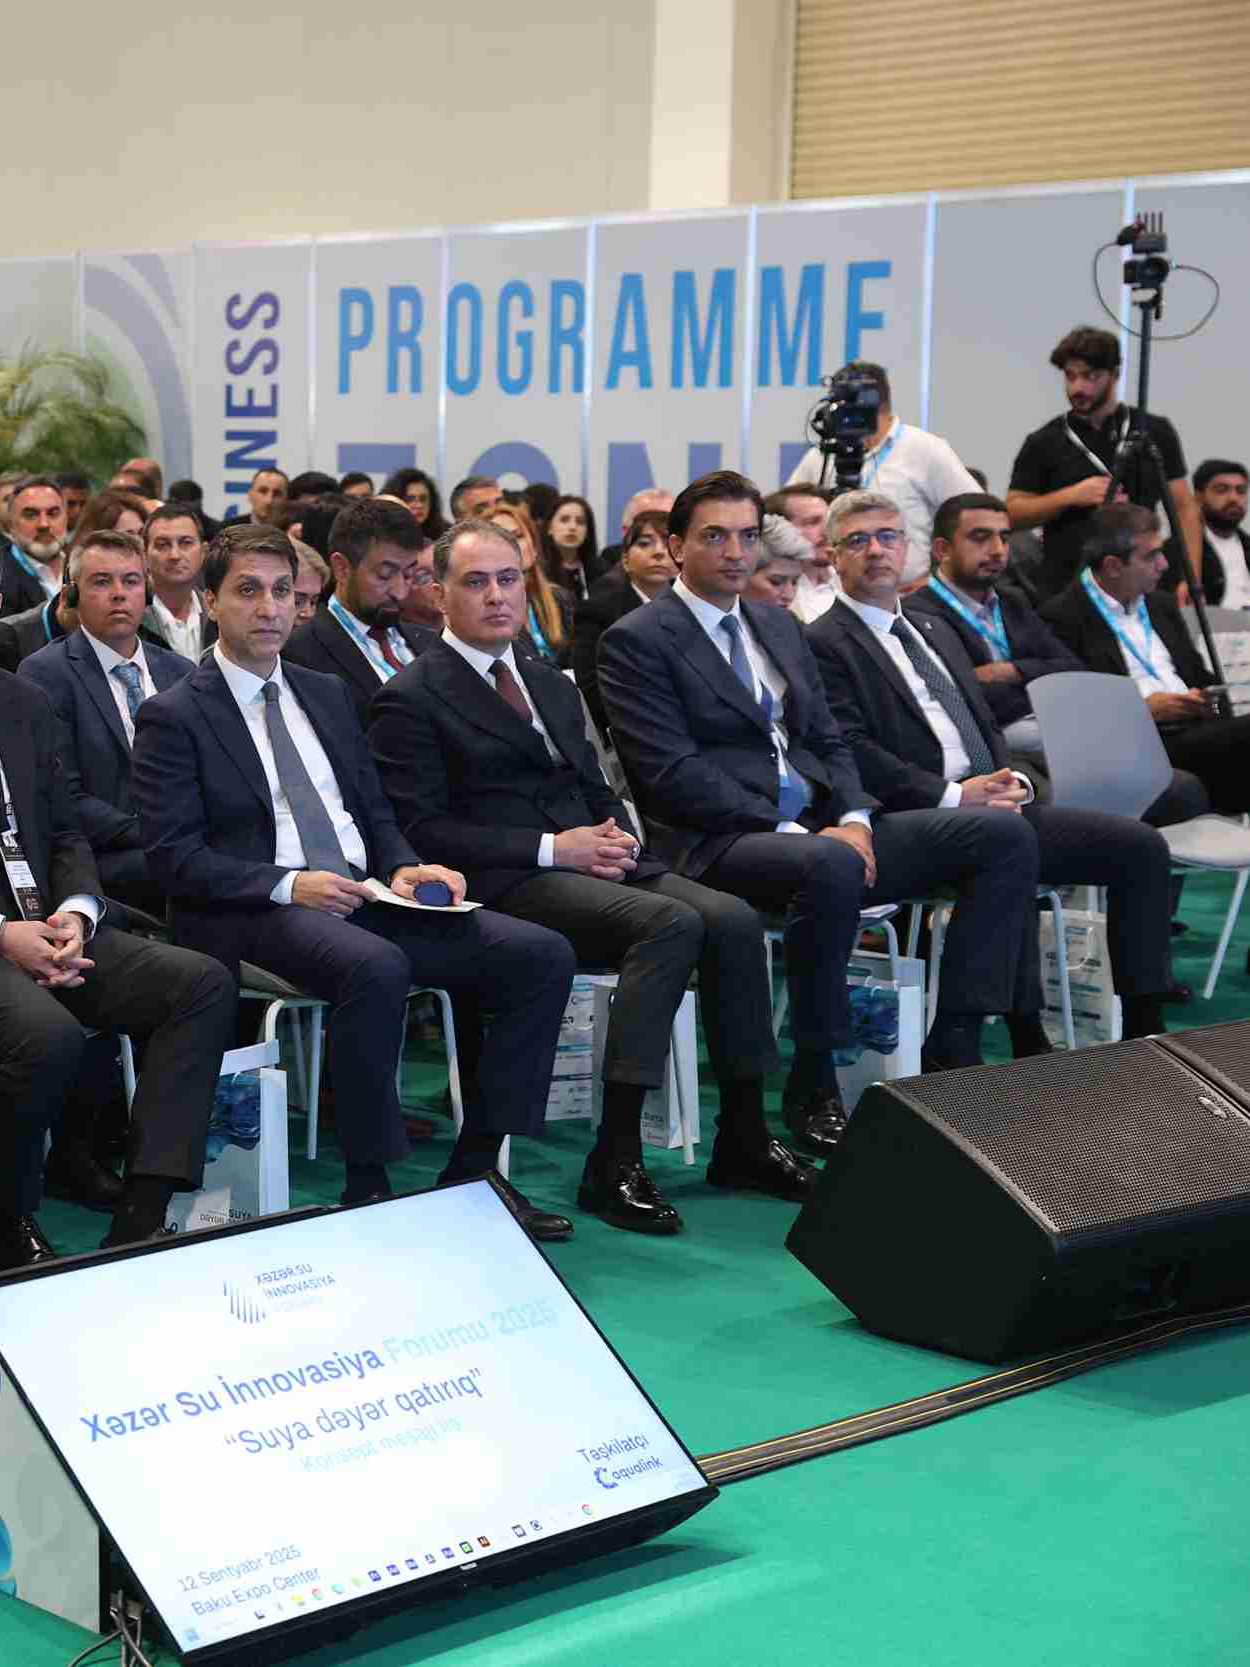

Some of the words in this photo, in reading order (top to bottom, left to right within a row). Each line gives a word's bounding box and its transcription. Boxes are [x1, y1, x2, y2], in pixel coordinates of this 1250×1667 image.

[337, 259, 893, 396] PROGRAMME
[223, 291, 280, 519] INESS
[79, 1402, 172, 1443] Xəzər
[174, 1390, 223, 1417] Su
[217, 1349, 386, 1405] İnnovasiya
[381, 1320, 490, 1365] Forumu
[314, 1396, 390, 1431] dəyər
[177, 1575, 199, 1593] 12
[197, 1556, 263, 1587] Sentyabr
[190, 1594, 232, 1616] Baku
[231, 1583, 272, 1603] Expo
[272, 1567, 320, 1591] Center
